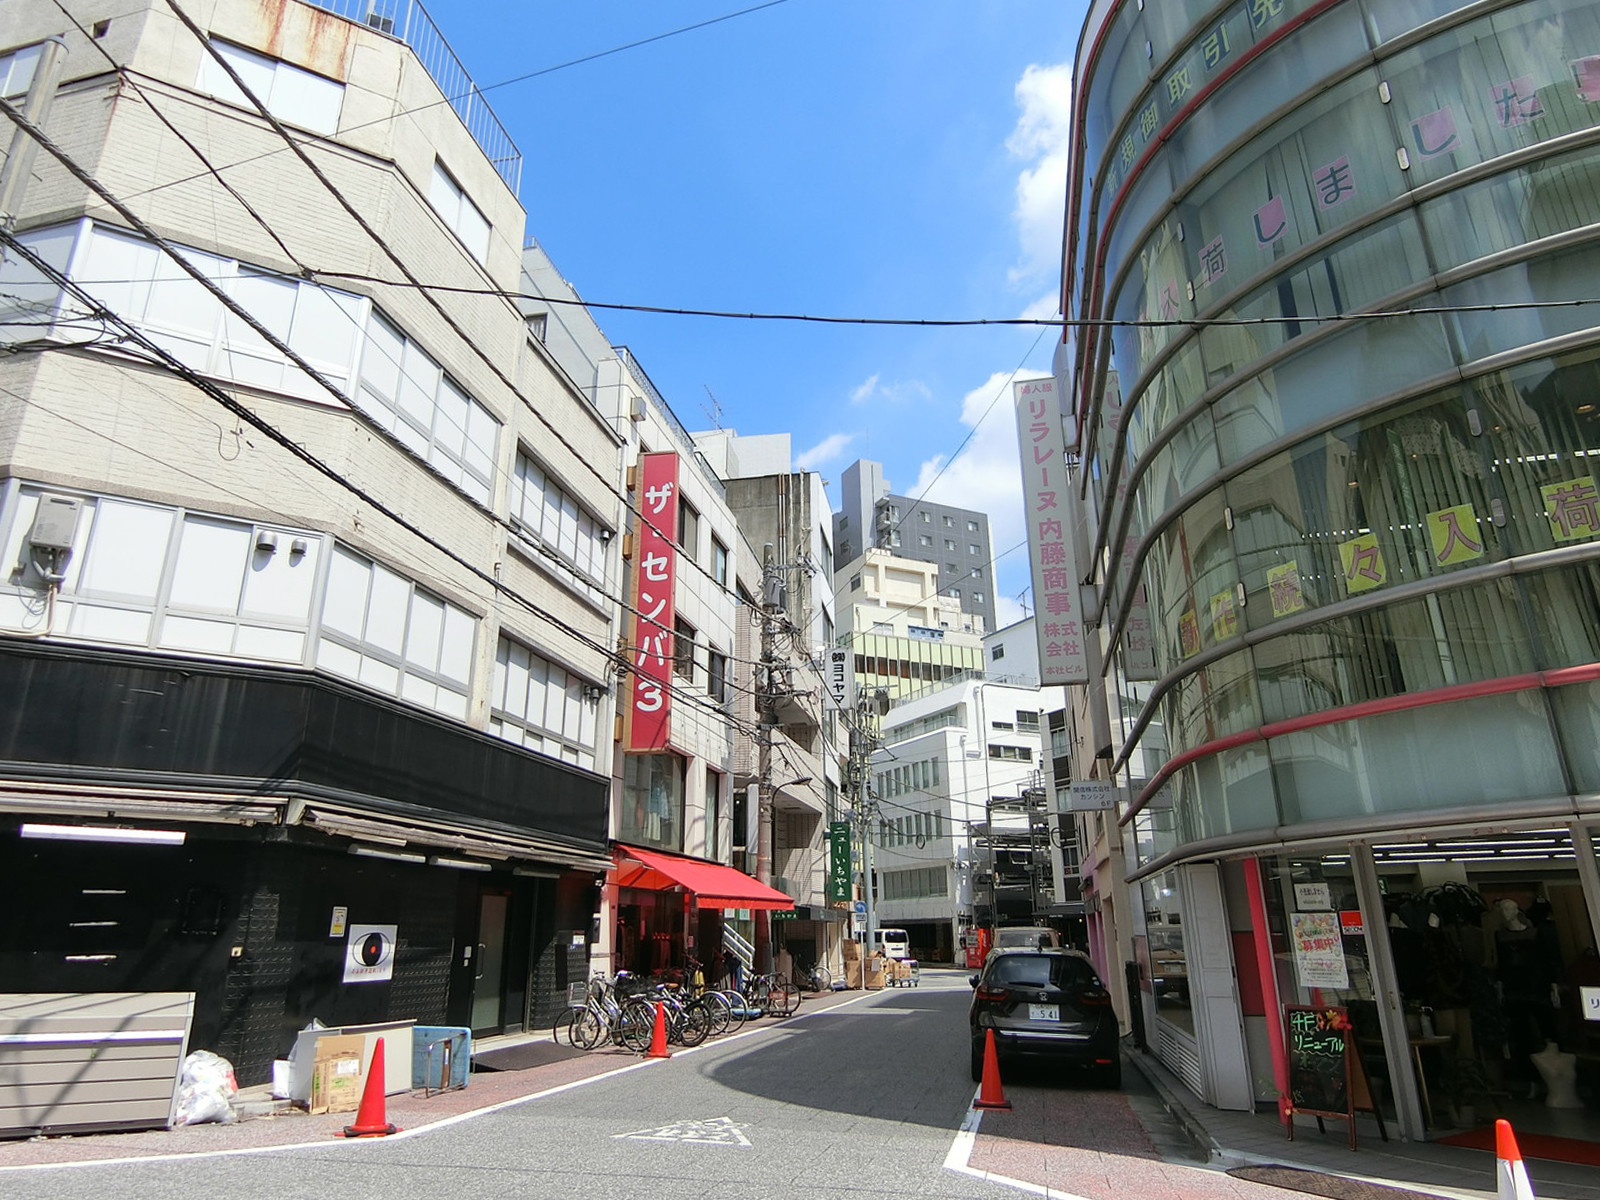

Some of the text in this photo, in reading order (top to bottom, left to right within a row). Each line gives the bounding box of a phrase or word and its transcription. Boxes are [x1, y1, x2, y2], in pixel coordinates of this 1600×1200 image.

[1046, 665, 1084, 675] 本社ビル
[834, 827, 847, 897] ニューいちやま
[1292, 1013, 1315, 1031] 4F
[1294, 1034, 1344, 1053] リニューアル
